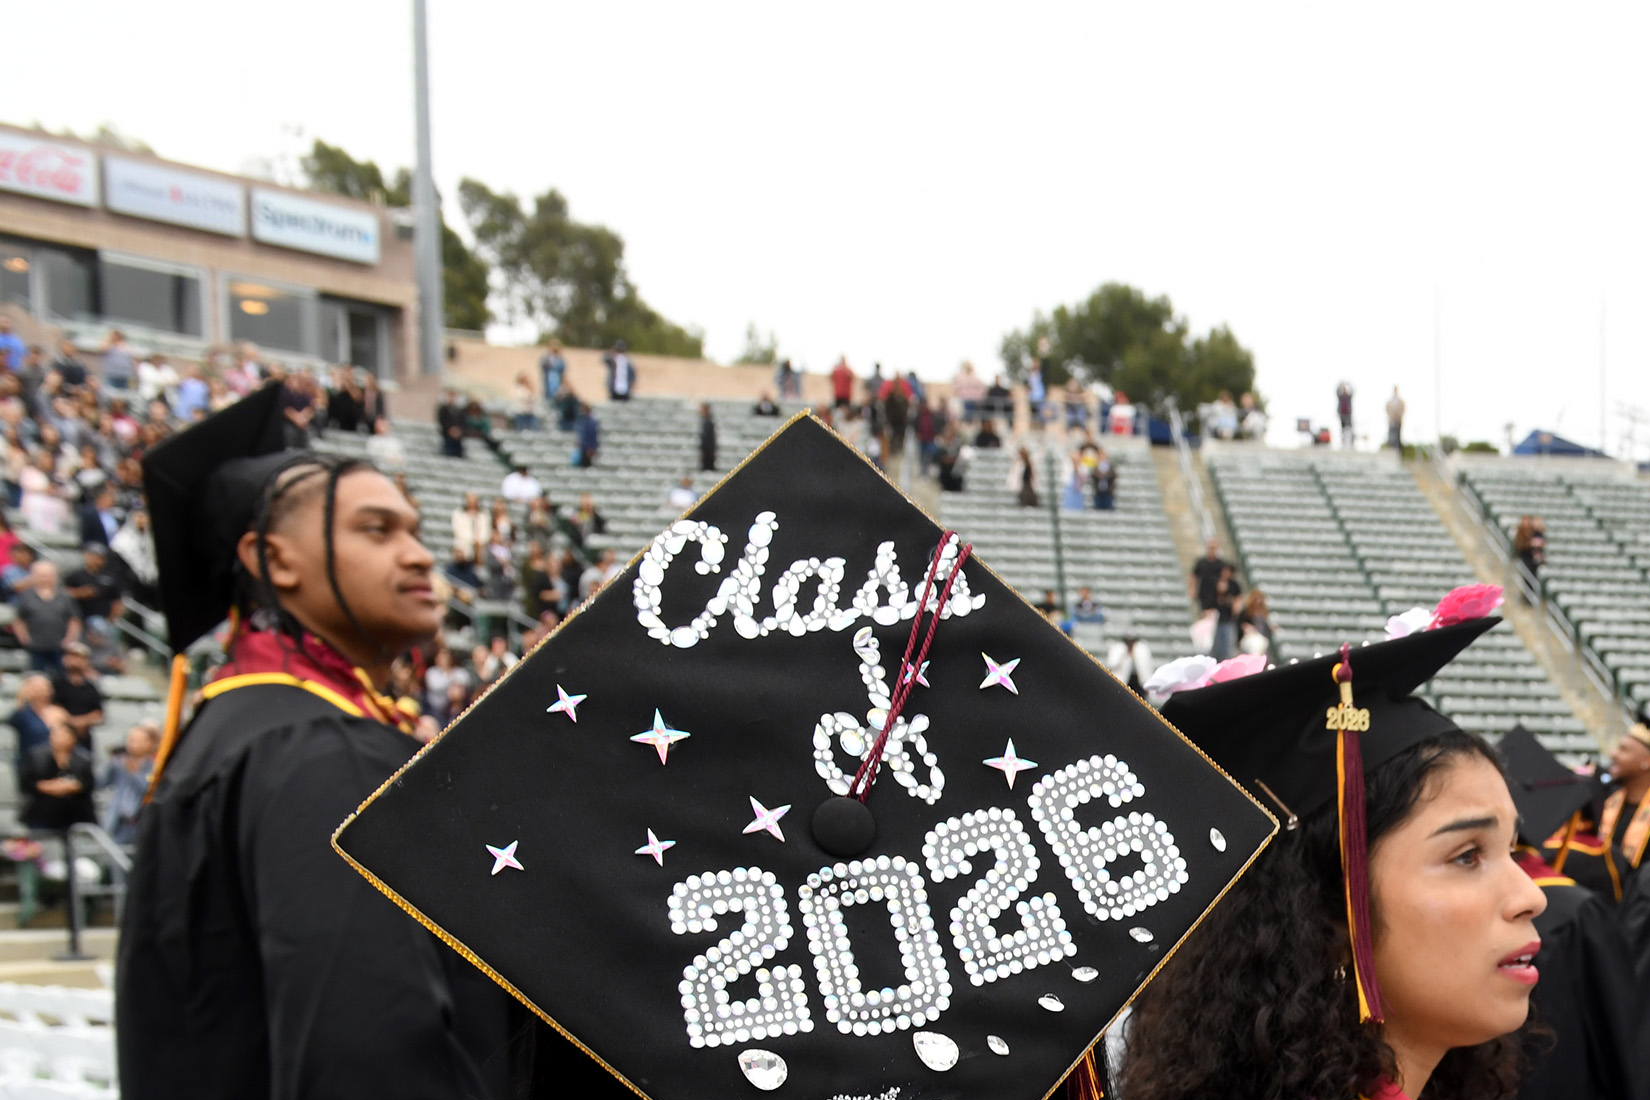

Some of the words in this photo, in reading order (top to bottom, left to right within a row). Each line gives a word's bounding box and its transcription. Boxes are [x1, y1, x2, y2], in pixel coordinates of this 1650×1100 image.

[259, 201, 366, 242] Spectrum
[633, 510, 987, 649] Class
[812, 626, 945, 805] of
[1326, 705, 1370, 732] 2026
[667, 753, 1190, 1049] 2026
